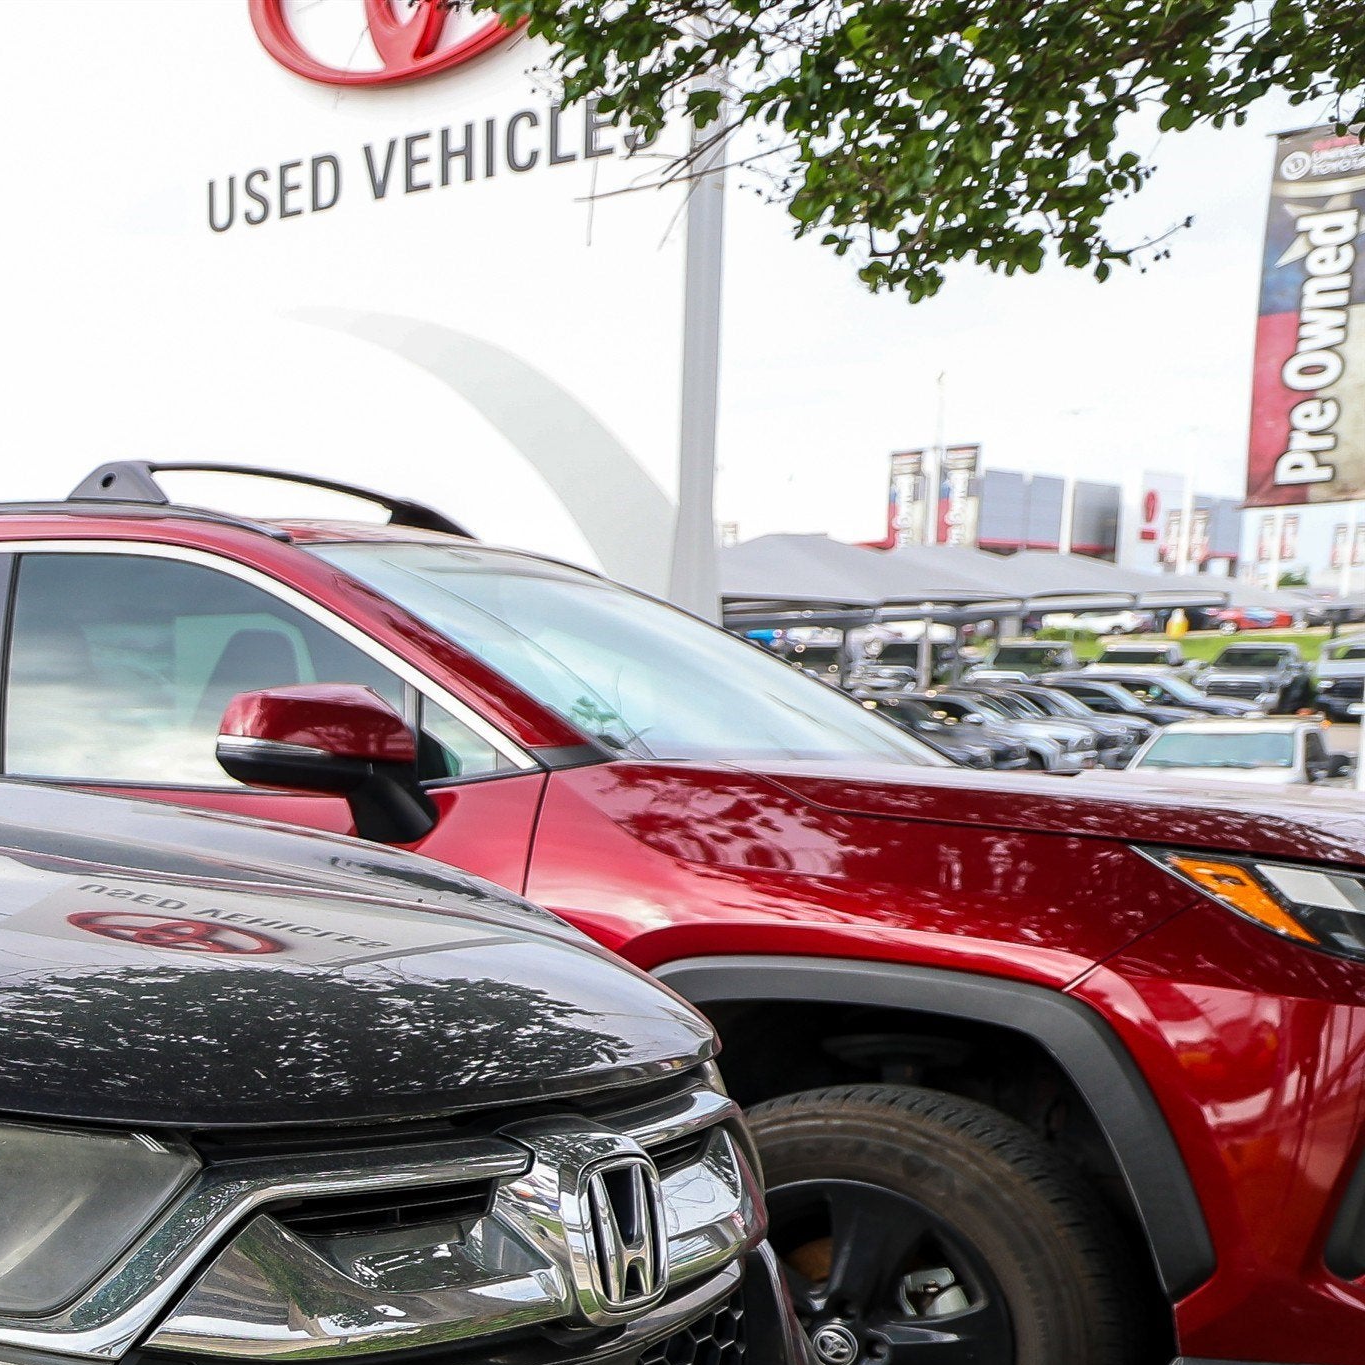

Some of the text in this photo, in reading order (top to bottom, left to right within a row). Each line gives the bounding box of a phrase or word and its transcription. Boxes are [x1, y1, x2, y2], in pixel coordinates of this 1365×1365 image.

[207, 154, 340, 233] USED
[1281, 208, 1360, 392] Owned
[1273, 396, 1341, 487] Pre
